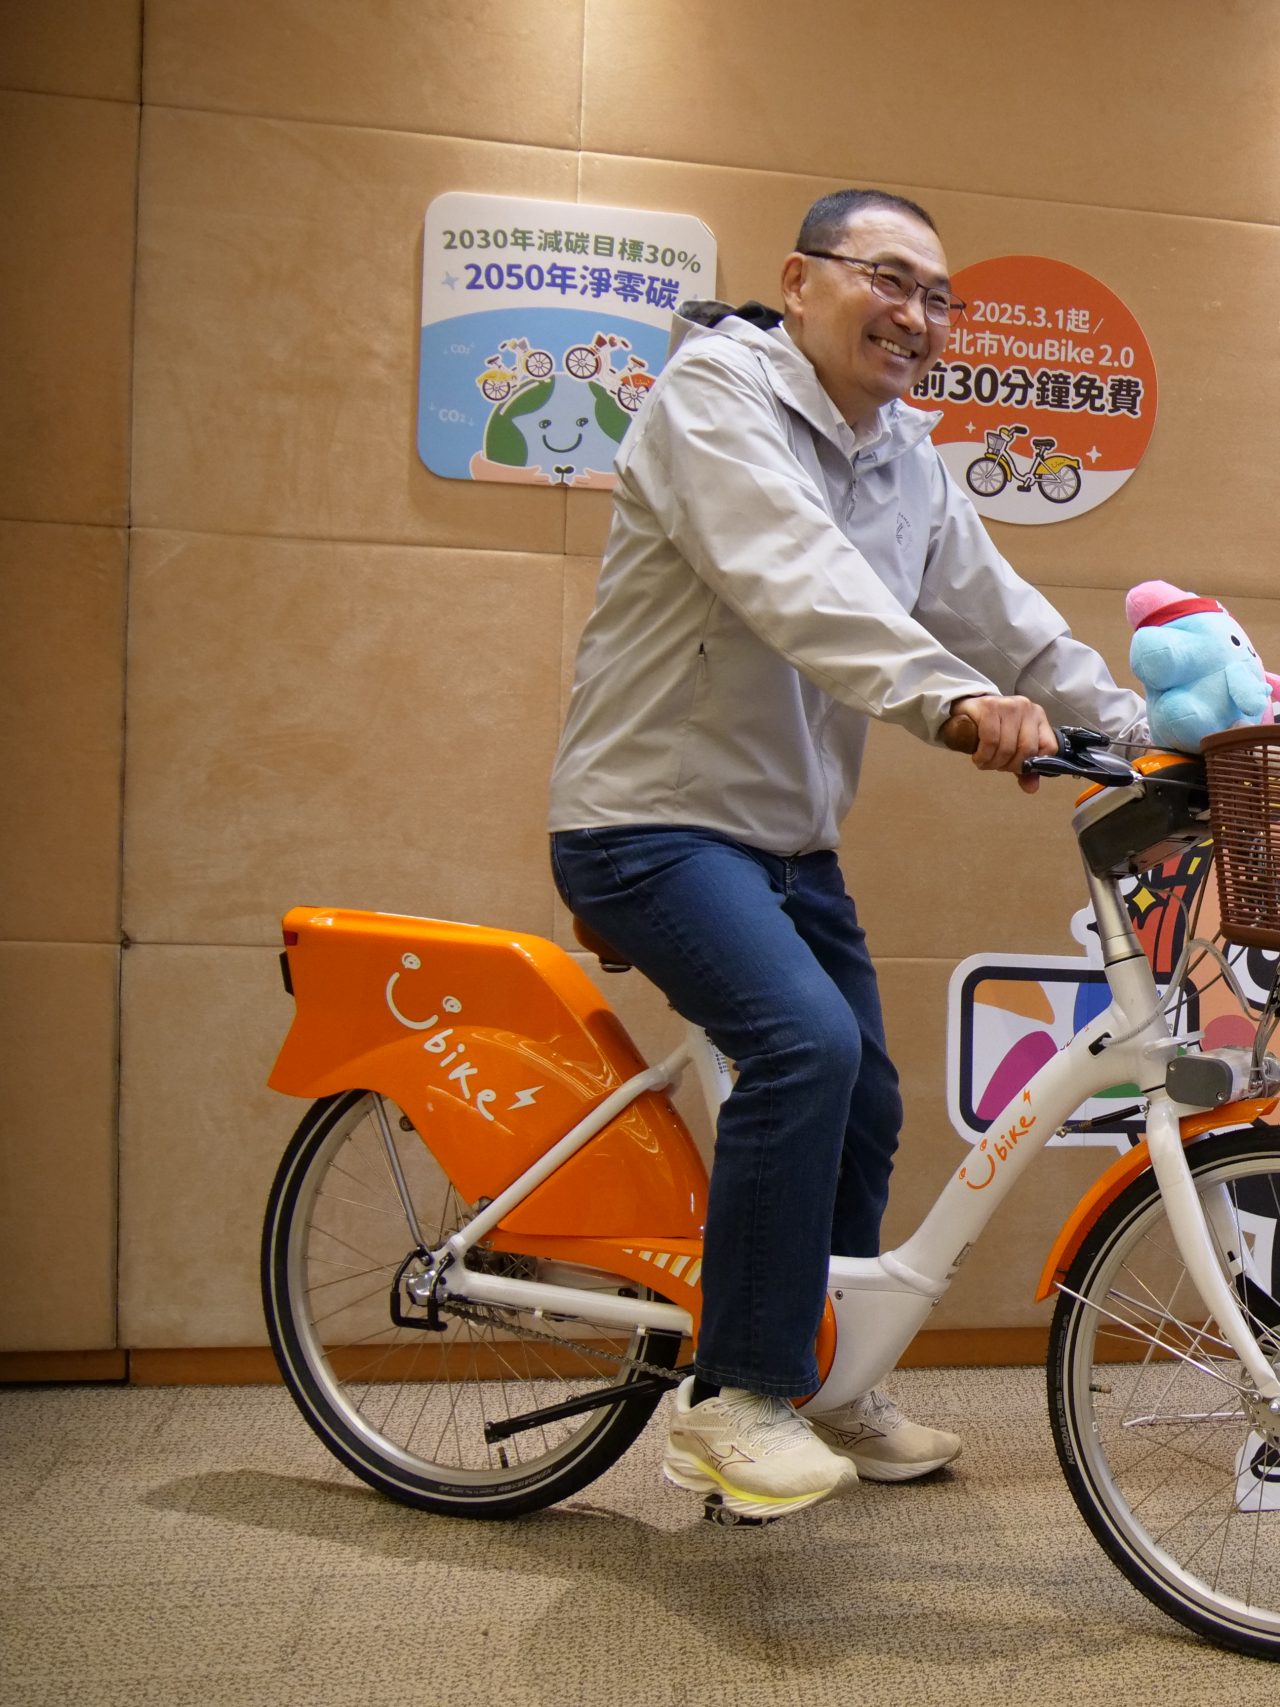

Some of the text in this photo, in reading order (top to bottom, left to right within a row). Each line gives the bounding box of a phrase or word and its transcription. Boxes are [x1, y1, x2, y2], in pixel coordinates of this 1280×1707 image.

[442, 228, 702, 274] 2030年減碳目標30%
[464, 263, 681, 311] 2050年淨零碳
[972, 300, 1090, 334] 2025.3.1起
[943, 327, 1135, 368] 北市YouBike 2.0
[912, 361, 1142, 416] 前30分鐘免費
